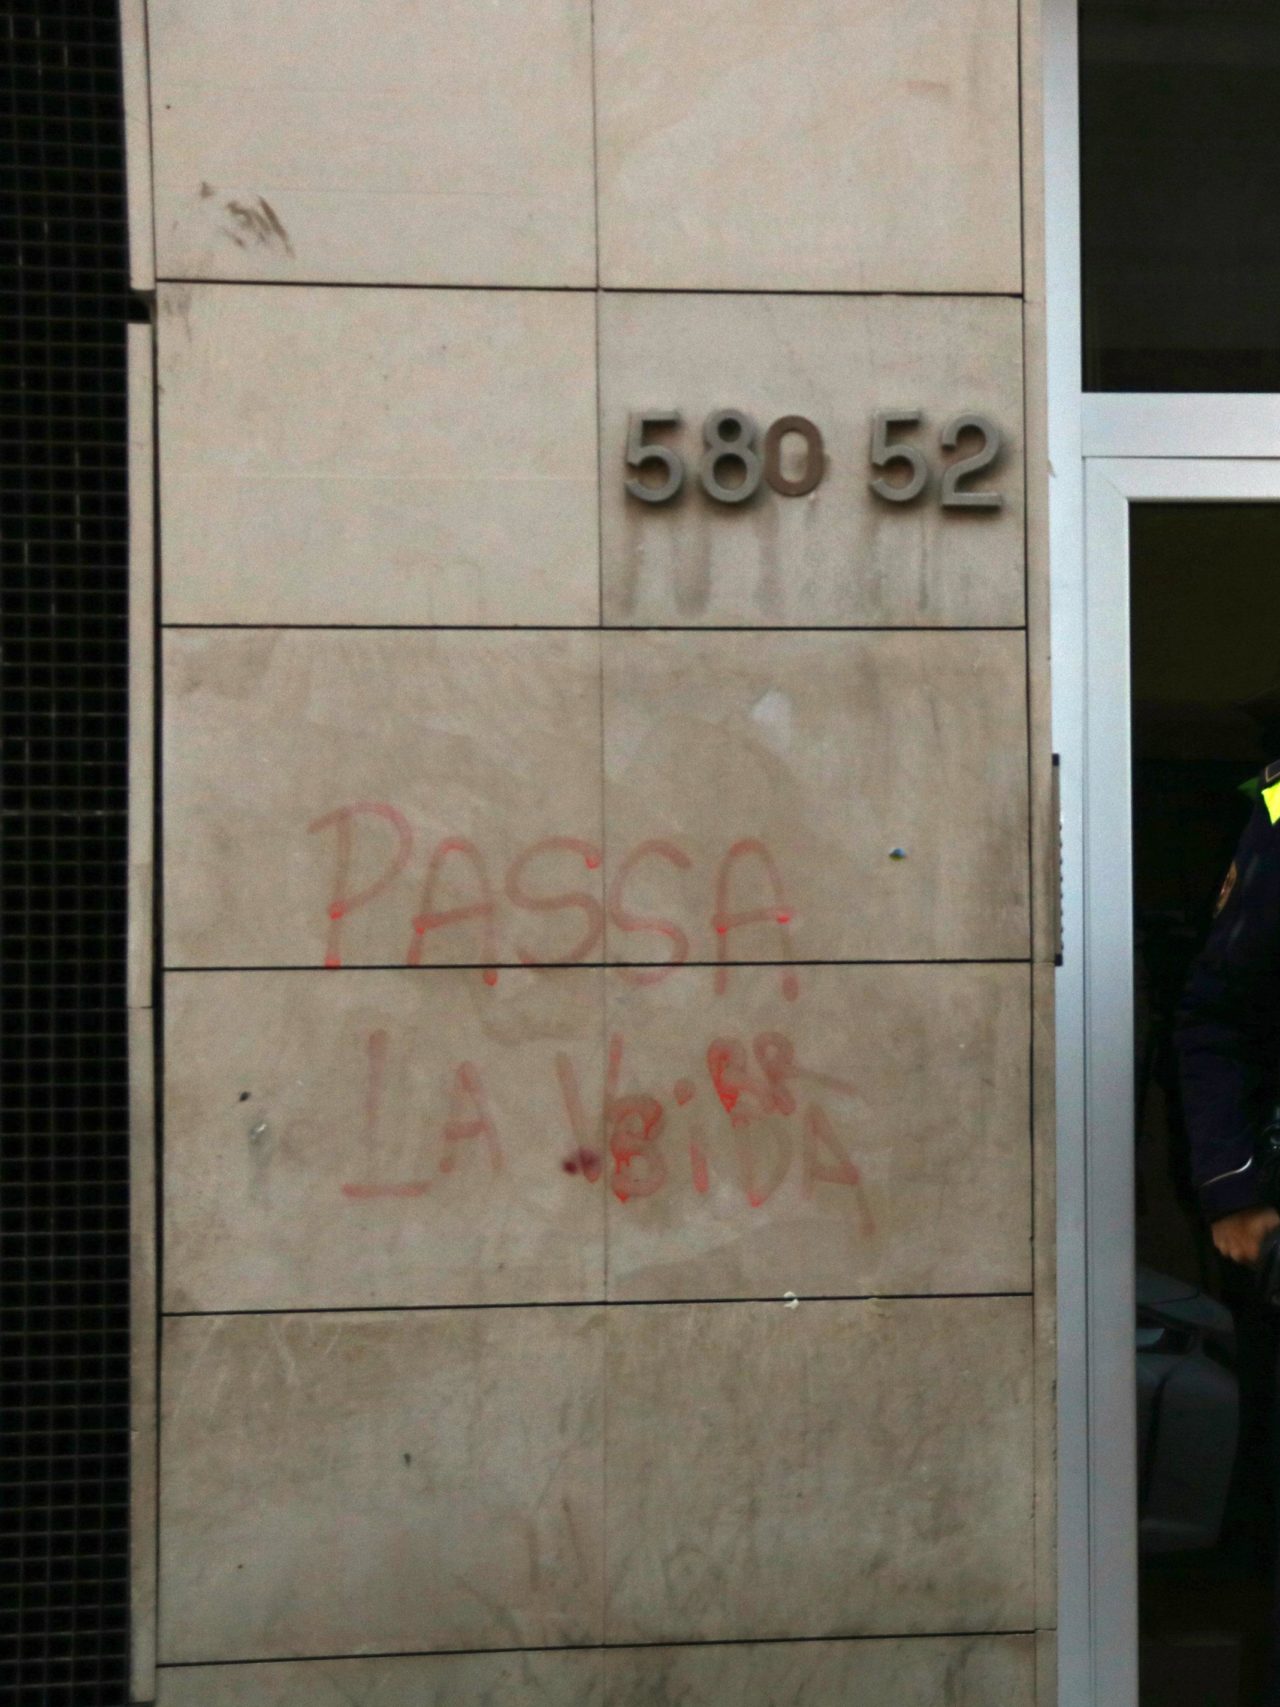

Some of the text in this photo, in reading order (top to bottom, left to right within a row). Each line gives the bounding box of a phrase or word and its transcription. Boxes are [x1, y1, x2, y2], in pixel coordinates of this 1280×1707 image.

[869, 409, 1003, 508] 52
[308, 800, 799, 1001] PASSA
[341, 1029, 506, 1198] LA
